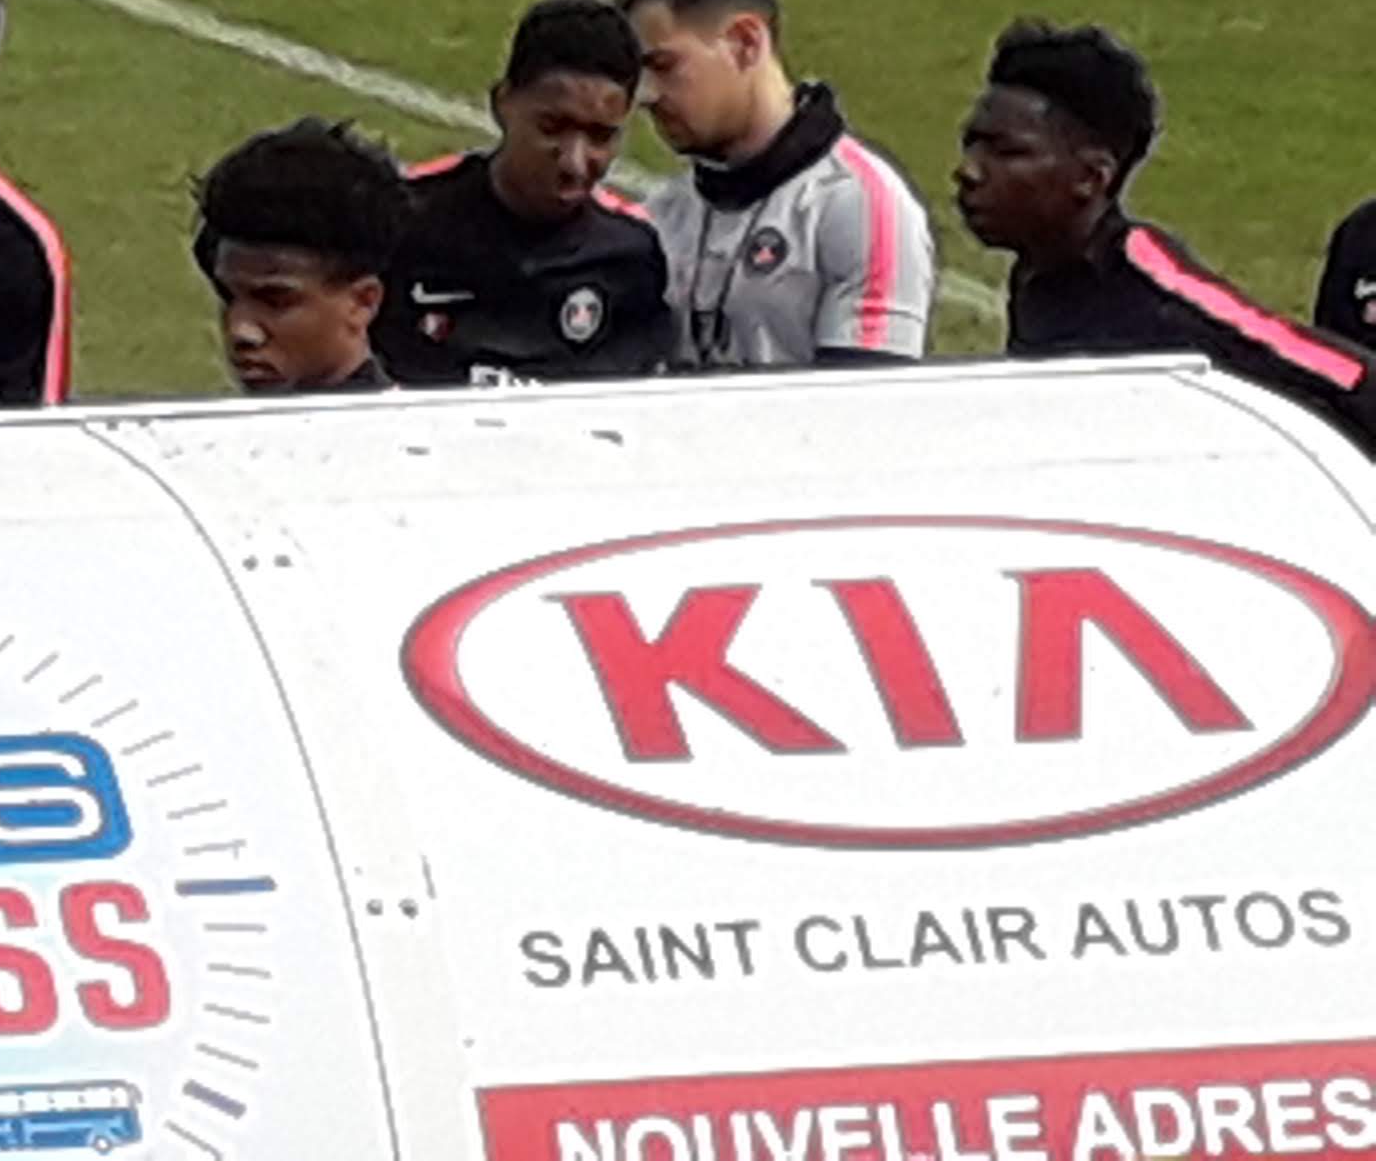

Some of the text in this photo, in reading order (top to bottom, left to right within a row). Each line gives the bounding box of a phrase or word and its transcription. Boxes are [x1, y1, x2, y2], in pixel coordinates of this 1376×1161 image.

[545, 566, 1256, 763] KIA
[519, 890, 1351, 989] SAINT CLAIR AUTOS
